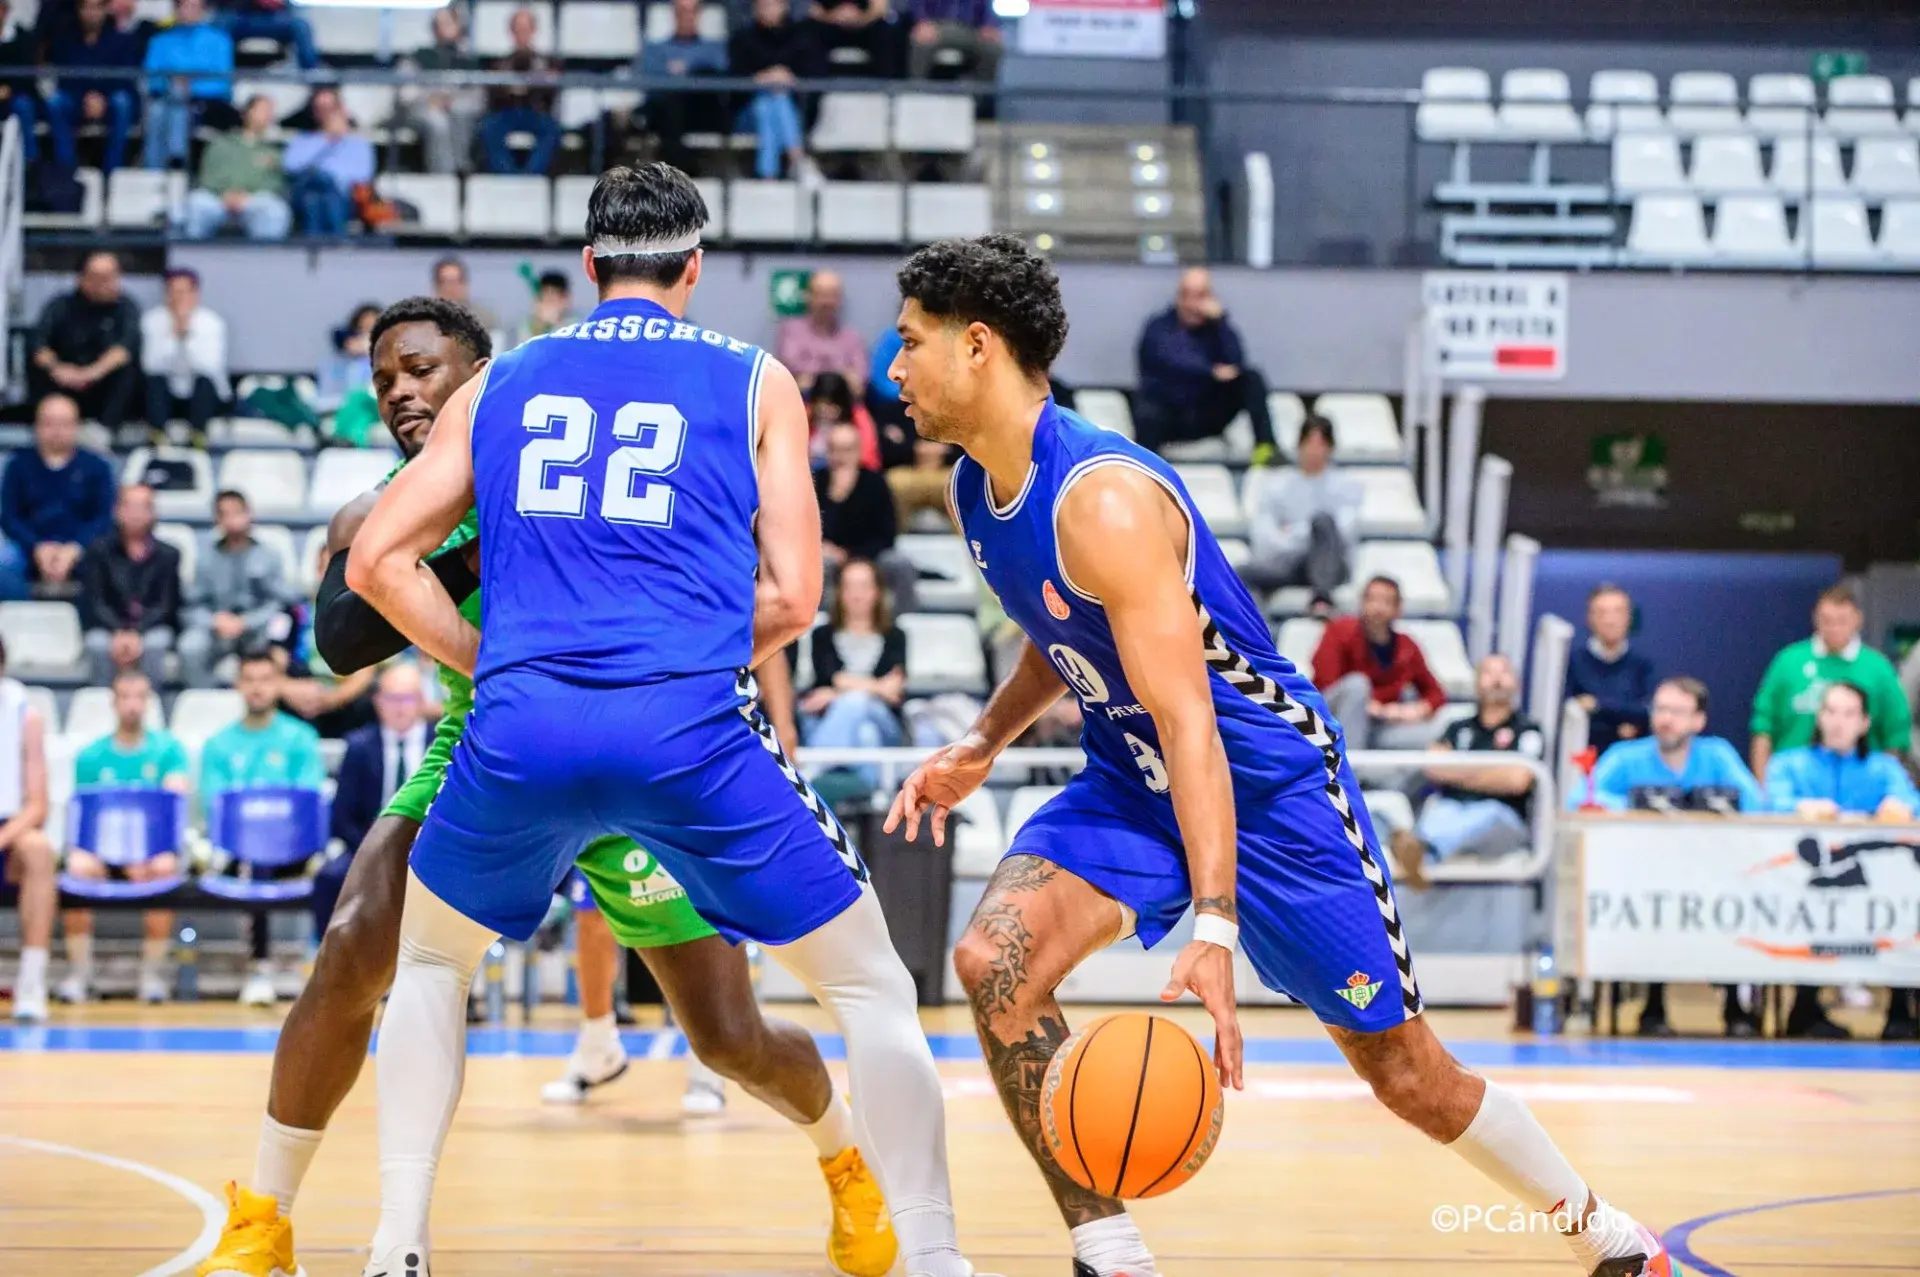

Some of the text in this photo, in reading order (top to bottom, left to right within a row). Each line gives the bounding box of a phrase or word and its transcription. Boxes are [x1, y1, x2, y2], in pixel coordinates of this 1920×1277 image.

[516, 393, 688, 529] 22
[1105, 704, 1149, 721] HERE
[1123, 731, 1171, 794] 3
[1587, 889, 1920, 934] PATRONAT D'
